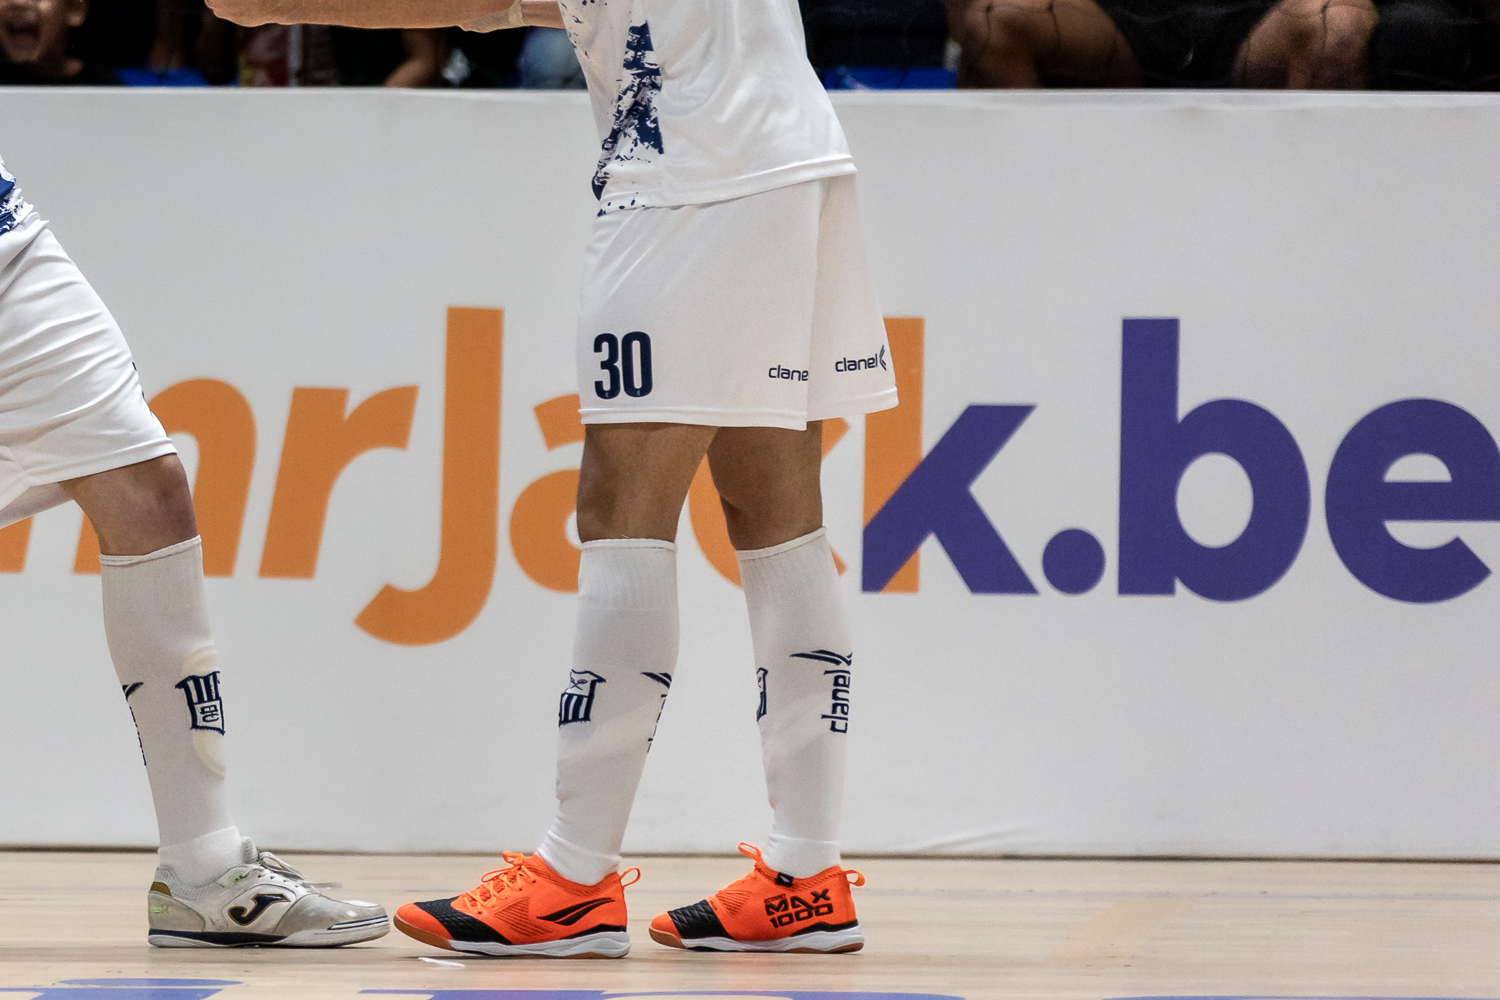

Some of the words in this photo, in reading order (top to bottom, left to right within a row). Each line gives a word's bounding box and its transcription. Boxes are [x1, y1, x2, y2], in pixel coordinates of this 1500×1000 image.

[593, 330, 653, 400] 30
[835, 353, 878, 372] clanel
[821, 669, 851, 734] clanel
[765, 888, 831, 916] MAX
[769, 903, 834, 929] 1000
